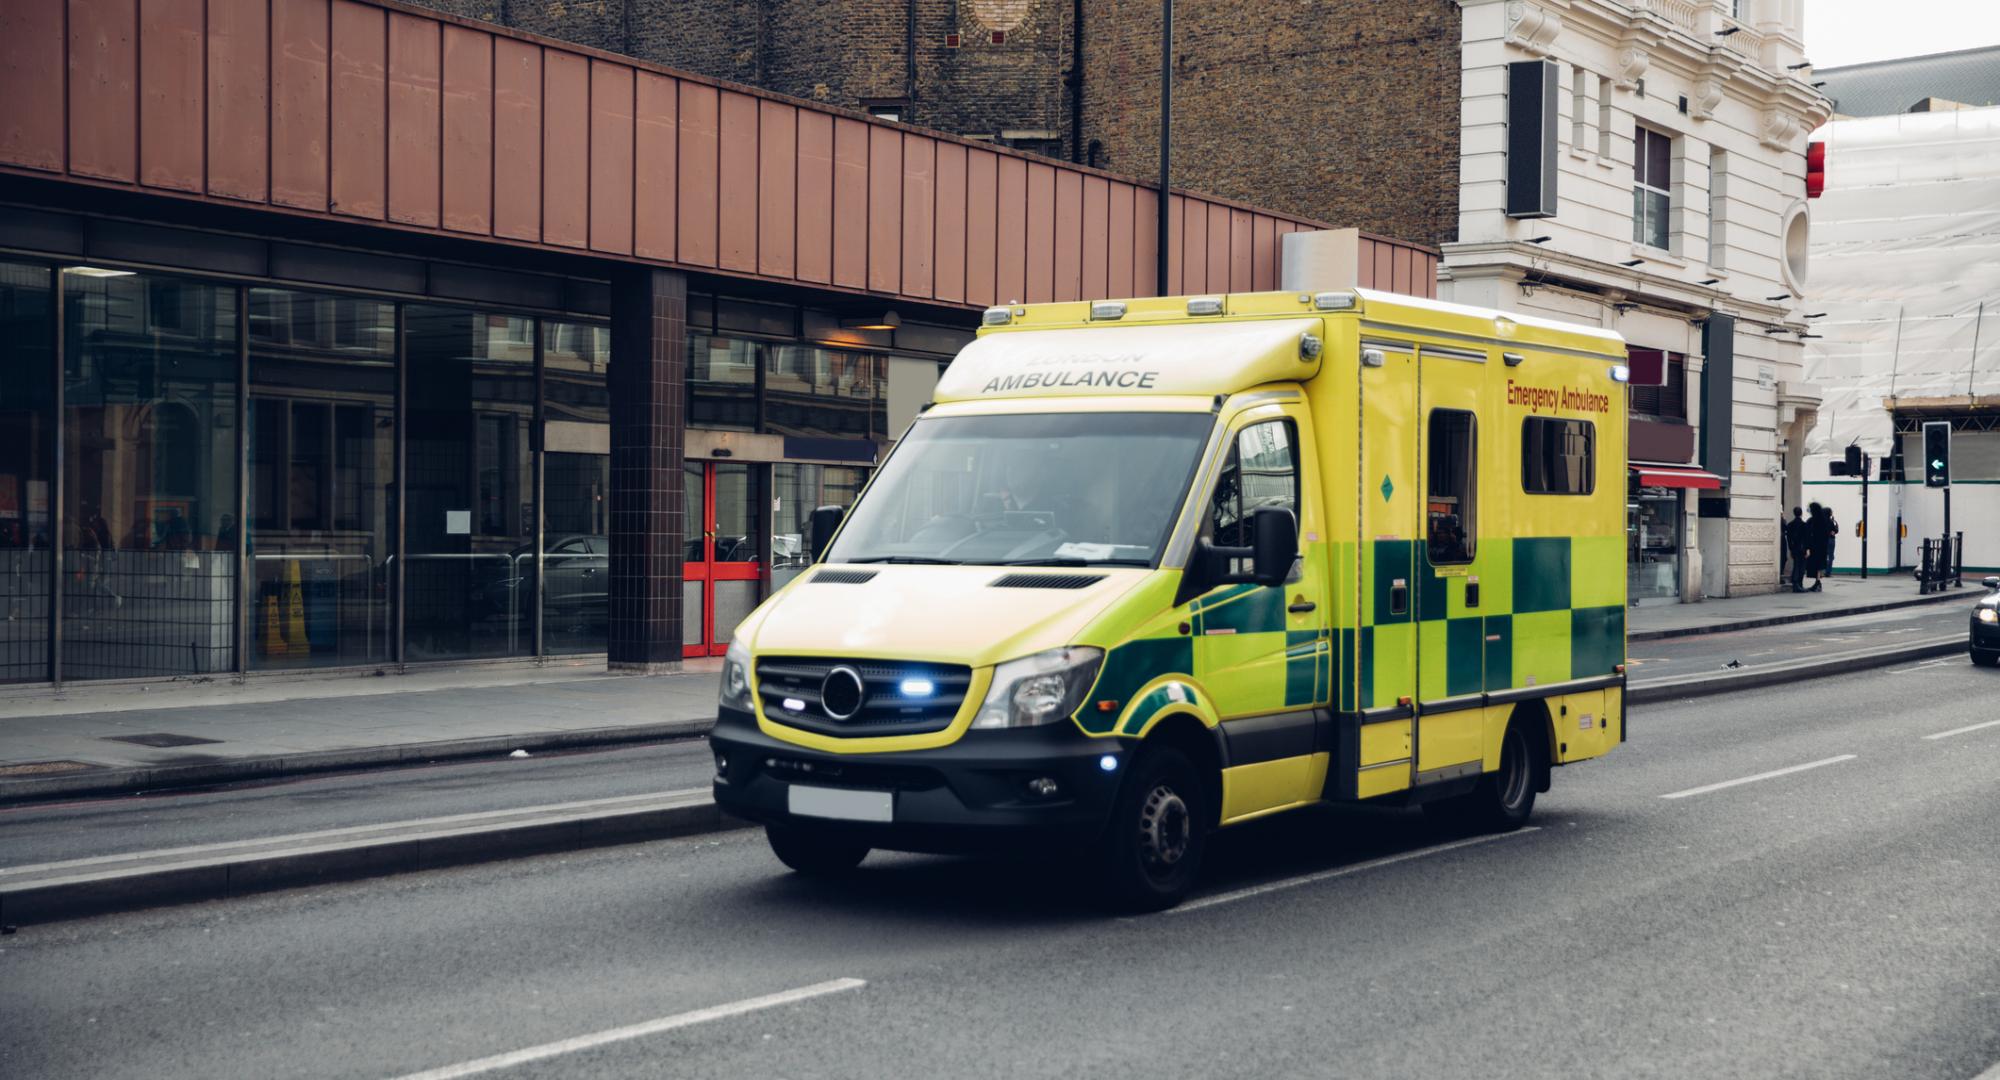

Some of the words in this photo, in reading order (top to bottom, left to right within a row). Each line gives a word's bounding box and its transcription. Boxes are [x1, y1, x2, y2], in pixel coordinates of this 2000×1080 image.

[982, 371, 1159, 393] AMBULANCE
[1508, 380, 1558, 414] Emergency
[1561, 386, 1608, 412] Ambulance
